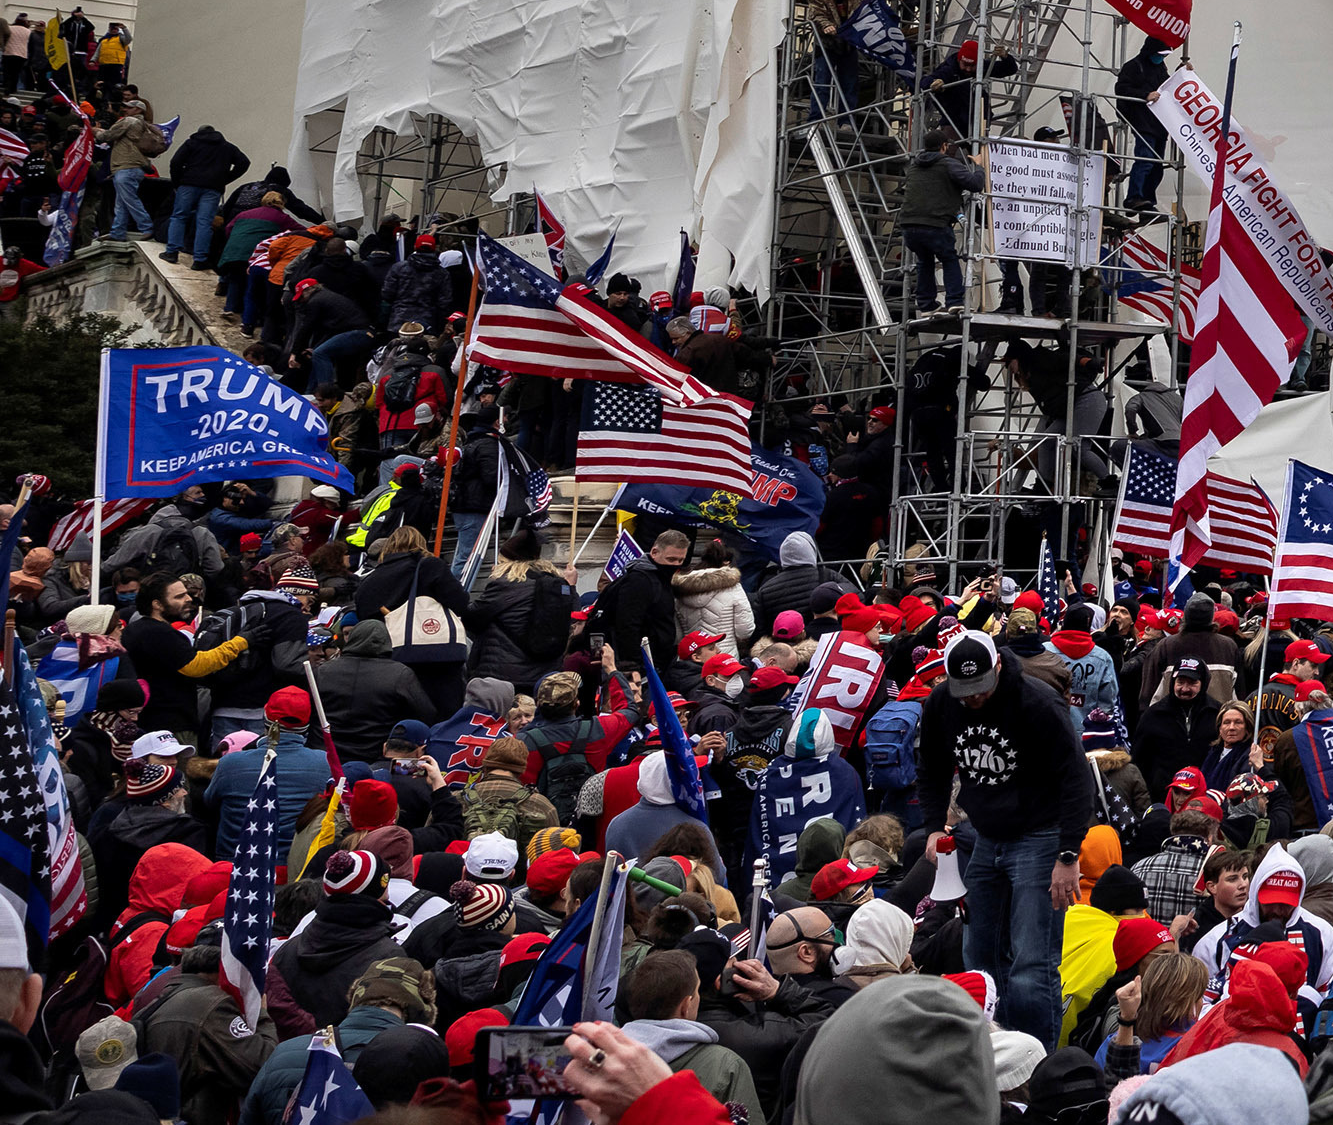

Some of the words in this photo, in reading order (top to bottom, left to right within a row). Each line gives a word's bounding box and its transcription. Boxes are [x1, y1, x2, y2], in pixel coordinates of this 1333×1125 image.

[988, 142, 1018, 156] When
[1020, 146, 1038, 158] bad
[1041, 152, 1060, 161] men
[990, 162, 1003, 173] he
[1005, 165, 1029, 177] good
[1032, 169, 1054, 178] must
[991, 180, 1004, 192] lse
[1006, 183, 1028, 197] they
[1030, 185, 1047, 197] will
[1007, 202, 1020, 212] an
[1023, 204, 1061, 217] unpitied
[1222, 183, 1275, 250] American
[1003, 221, 1066, 236] contemptible
[1249, 167, 1297, 231] FIGHT
[1288, 229, 1322, 278] FOR
[145, 367, 329, 435] TRUMP
[140, 455, 187, 473] KEEP
[188, 440, 256, 466] AMERICA
[688, 642, 699, 652] 45
[962, 743, 1006, 774] 1776
[759, 794, 771, 855] AMERICA
[1267, 878, 1284, 887] GREAT
[1284, 880, 1299, 888] AGAIN
